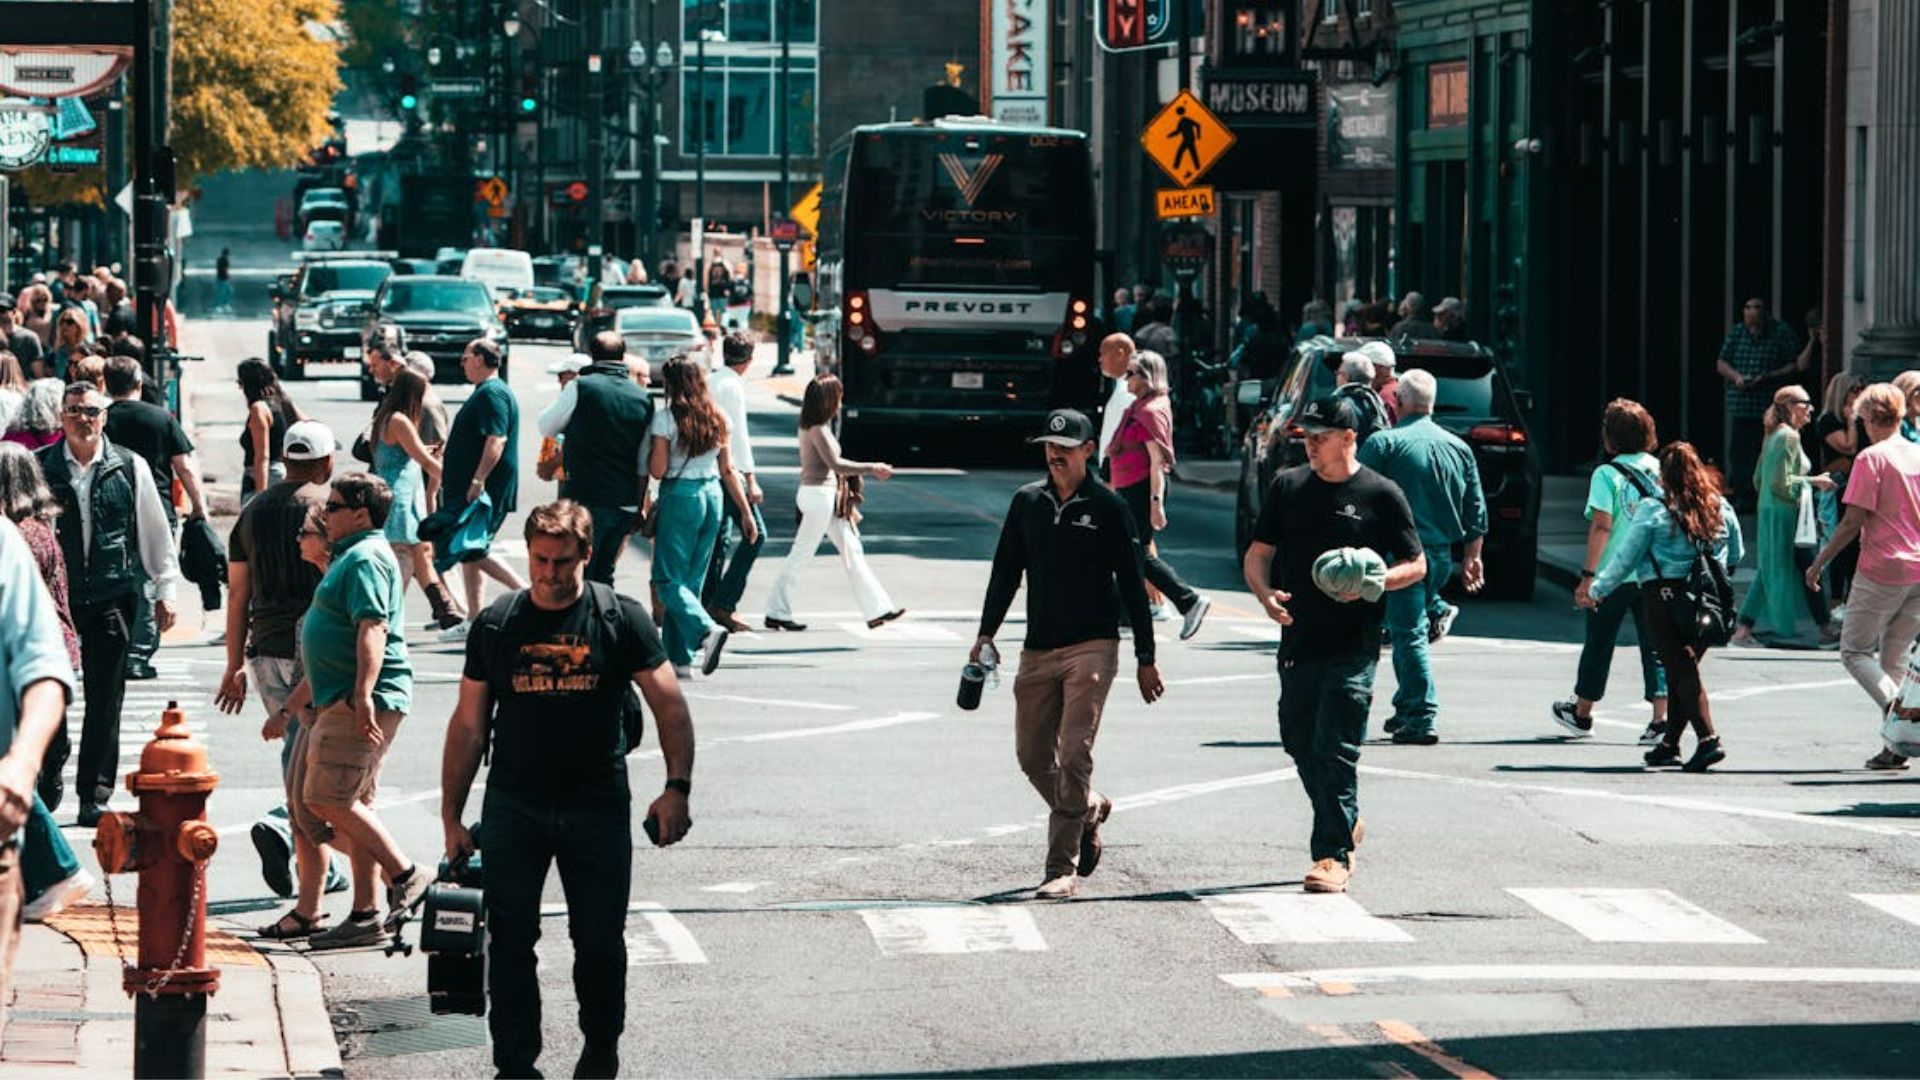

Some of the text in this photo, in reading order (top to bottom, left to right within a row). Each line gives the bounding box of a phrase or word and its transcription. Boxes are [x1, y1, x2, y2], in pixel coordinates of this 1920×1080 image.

[1209, 83, 1308, 113] MUSEUM
[1164, 193, 1210, 210] AHEAD
[922, 210, 1018, 221] VICTORY
[905, 301, 1032, 314] PREVOST
